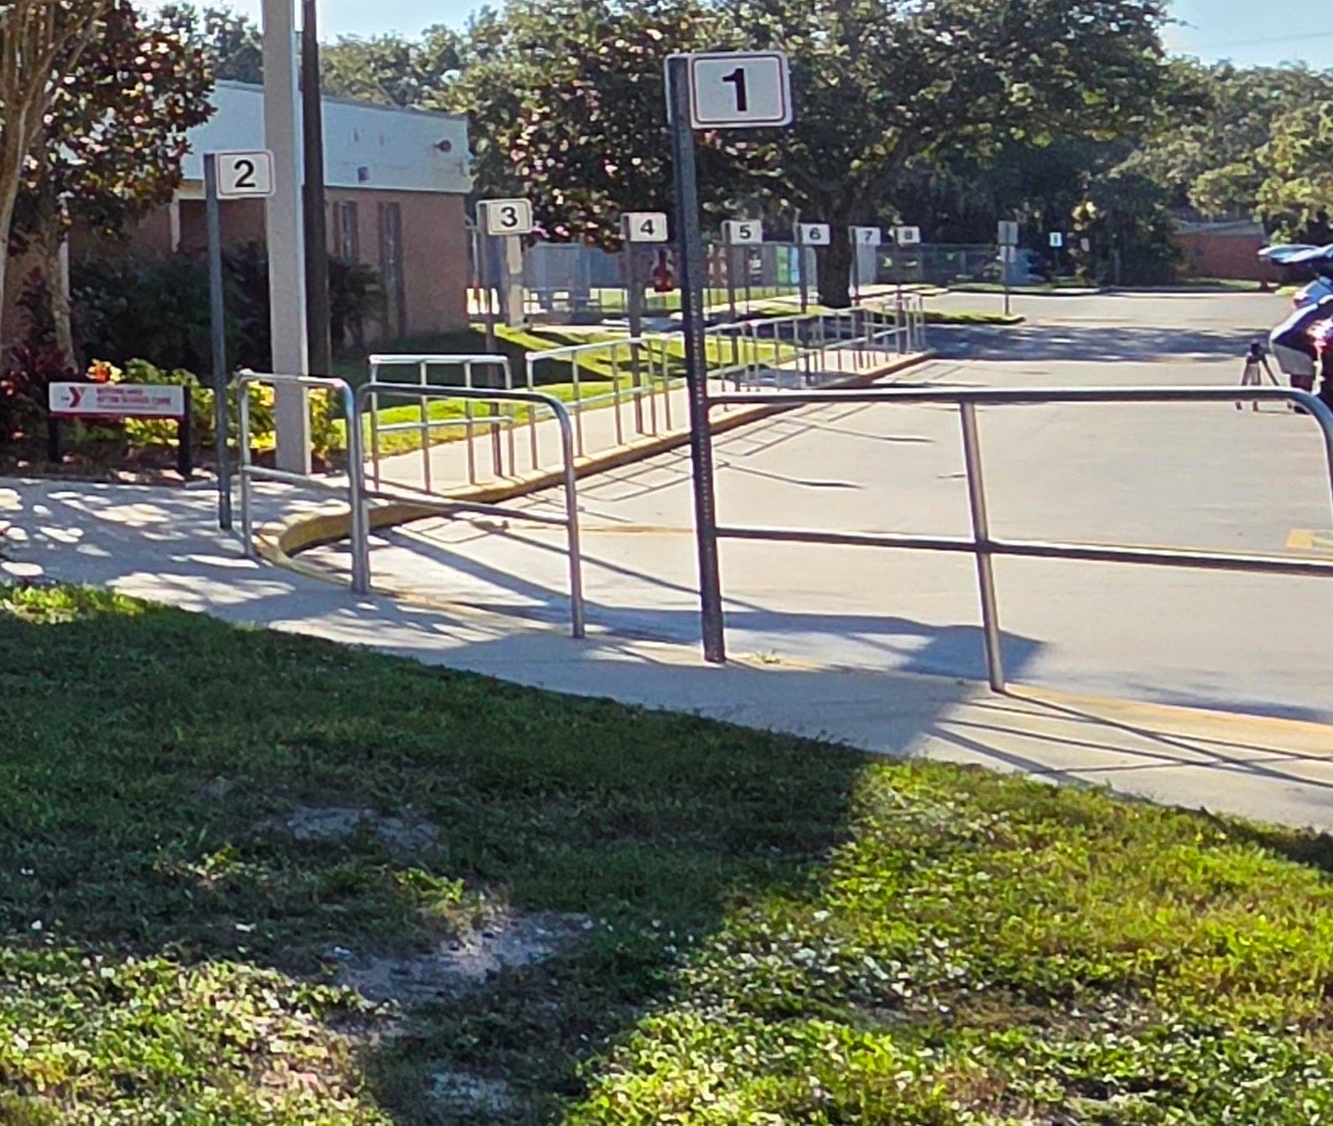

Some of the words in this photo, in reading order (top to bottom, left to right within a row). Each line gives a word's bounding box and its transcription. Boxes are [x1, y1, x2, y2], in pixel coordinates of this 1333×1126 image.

[722, 67, 748, 112] 1
[233, 159, 256, 188] 2
[500, 206, 518, 228] 3
[640, 218, 655, 236] 4
[739, 224, 752, 240] 5
[808, 227, 822, 241] 6
[863, 230, 873, 243] 7
